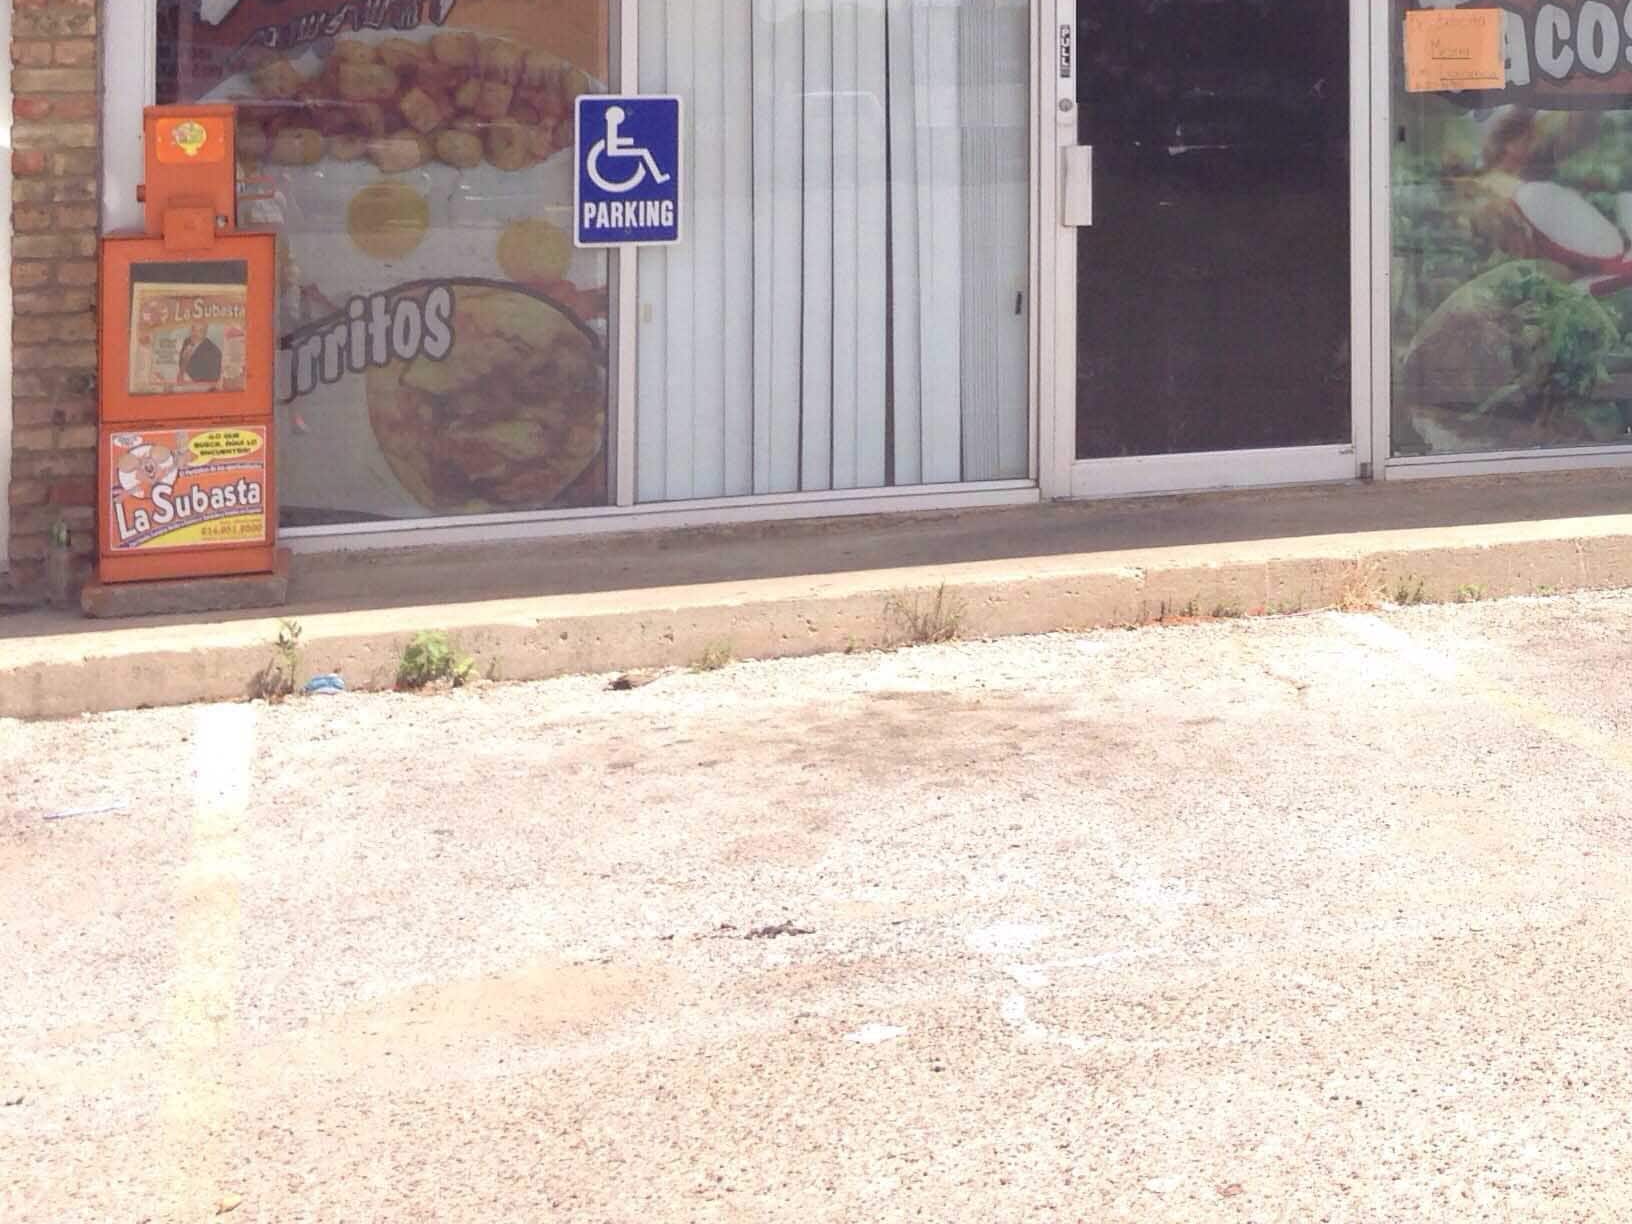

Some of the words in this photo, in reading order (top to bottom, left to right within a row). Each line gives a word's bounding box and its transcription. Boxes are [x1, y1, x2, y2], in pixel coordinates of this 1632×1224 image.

[1060, 27, 1071, 67] PULL
[582, 199, 675, 231] PARKING
[275, 286, 453, 402] rritos
[114, 501, 151, 540] La
[151, 478, 262, 524] Subasta
